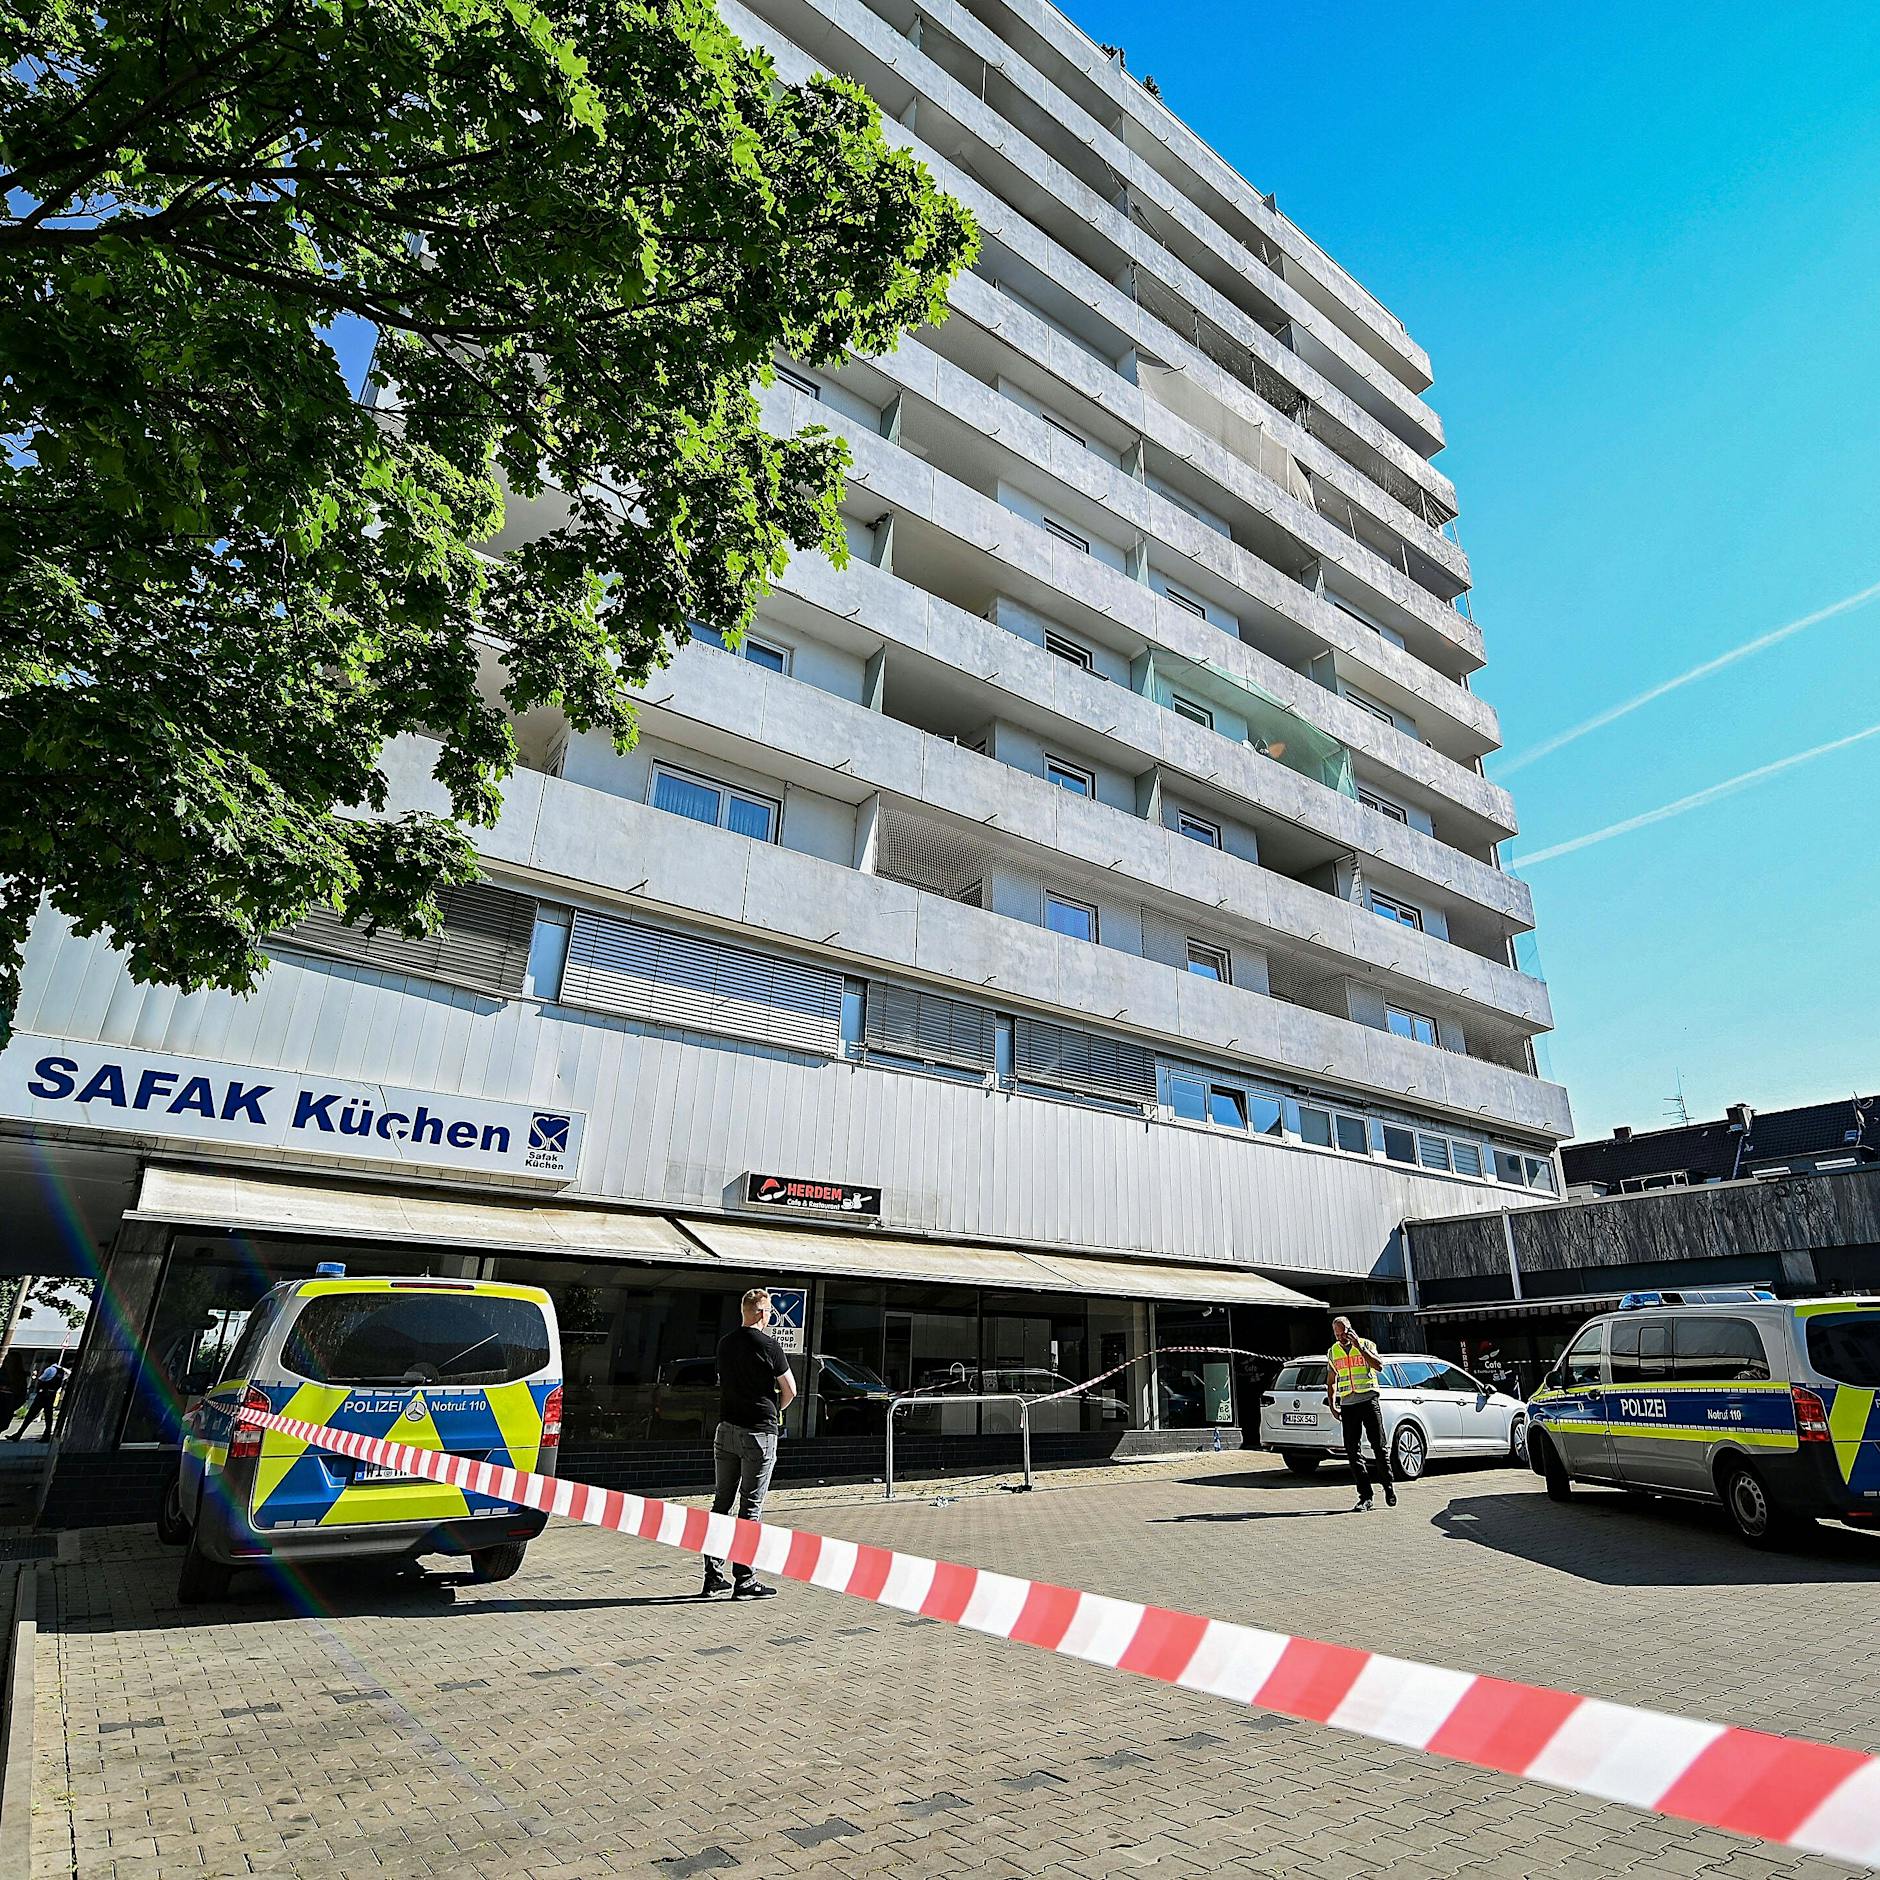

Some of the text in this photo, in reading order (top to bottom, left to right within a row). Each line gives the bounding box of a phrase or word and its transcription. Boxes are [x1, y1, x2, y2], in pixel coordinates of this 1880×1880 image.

[28, 1056, 511, 1153] SAFAK Küchen
[528, 1151, 558, 1161] Safak
[525, 1159, 564, 1170] Küchen
[787, 1183, 843, 1201] HERDEM
[802, 1199, 808, 1207] &
[809, 1201, 840, 1210] Restaurant
[1484, 1361, 1502, 1369] Cafe
[344, 1400, 486, 1413] POLIZEI Notruf 110
[1620, 1399, 1742, 1421] POLIZEI Notruf 110
